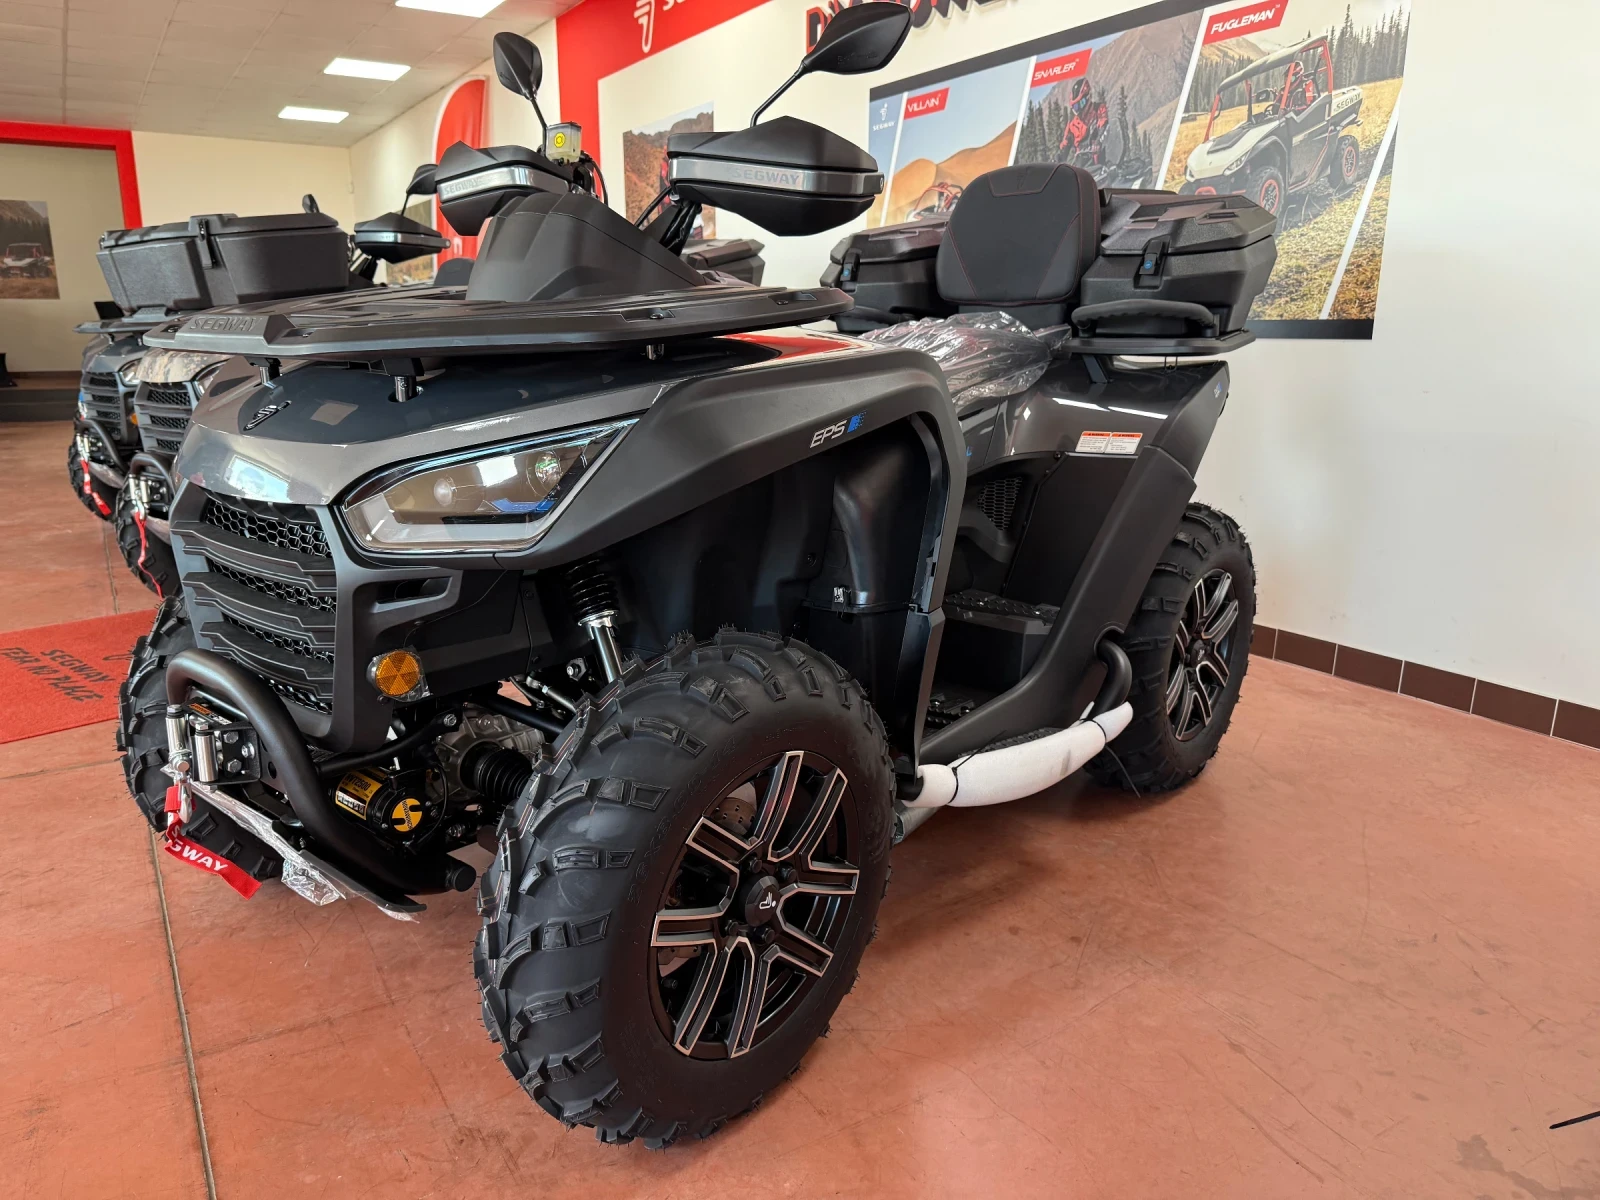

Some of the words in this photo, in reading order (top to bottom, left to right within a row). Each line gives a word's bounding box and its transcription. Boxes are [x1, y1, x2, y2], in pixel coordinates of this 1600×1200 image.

[1210, 8, 1275, 35] FUGLEMAN
[907, 97, 940, 113] VILLAIN
[732, 166, 800, 186] SEGWAY
[189, 316, 264, 332] SEGWAY
[810, 419, 848, 449] EPS
[40, 649, 116, 683] SEGWAY
